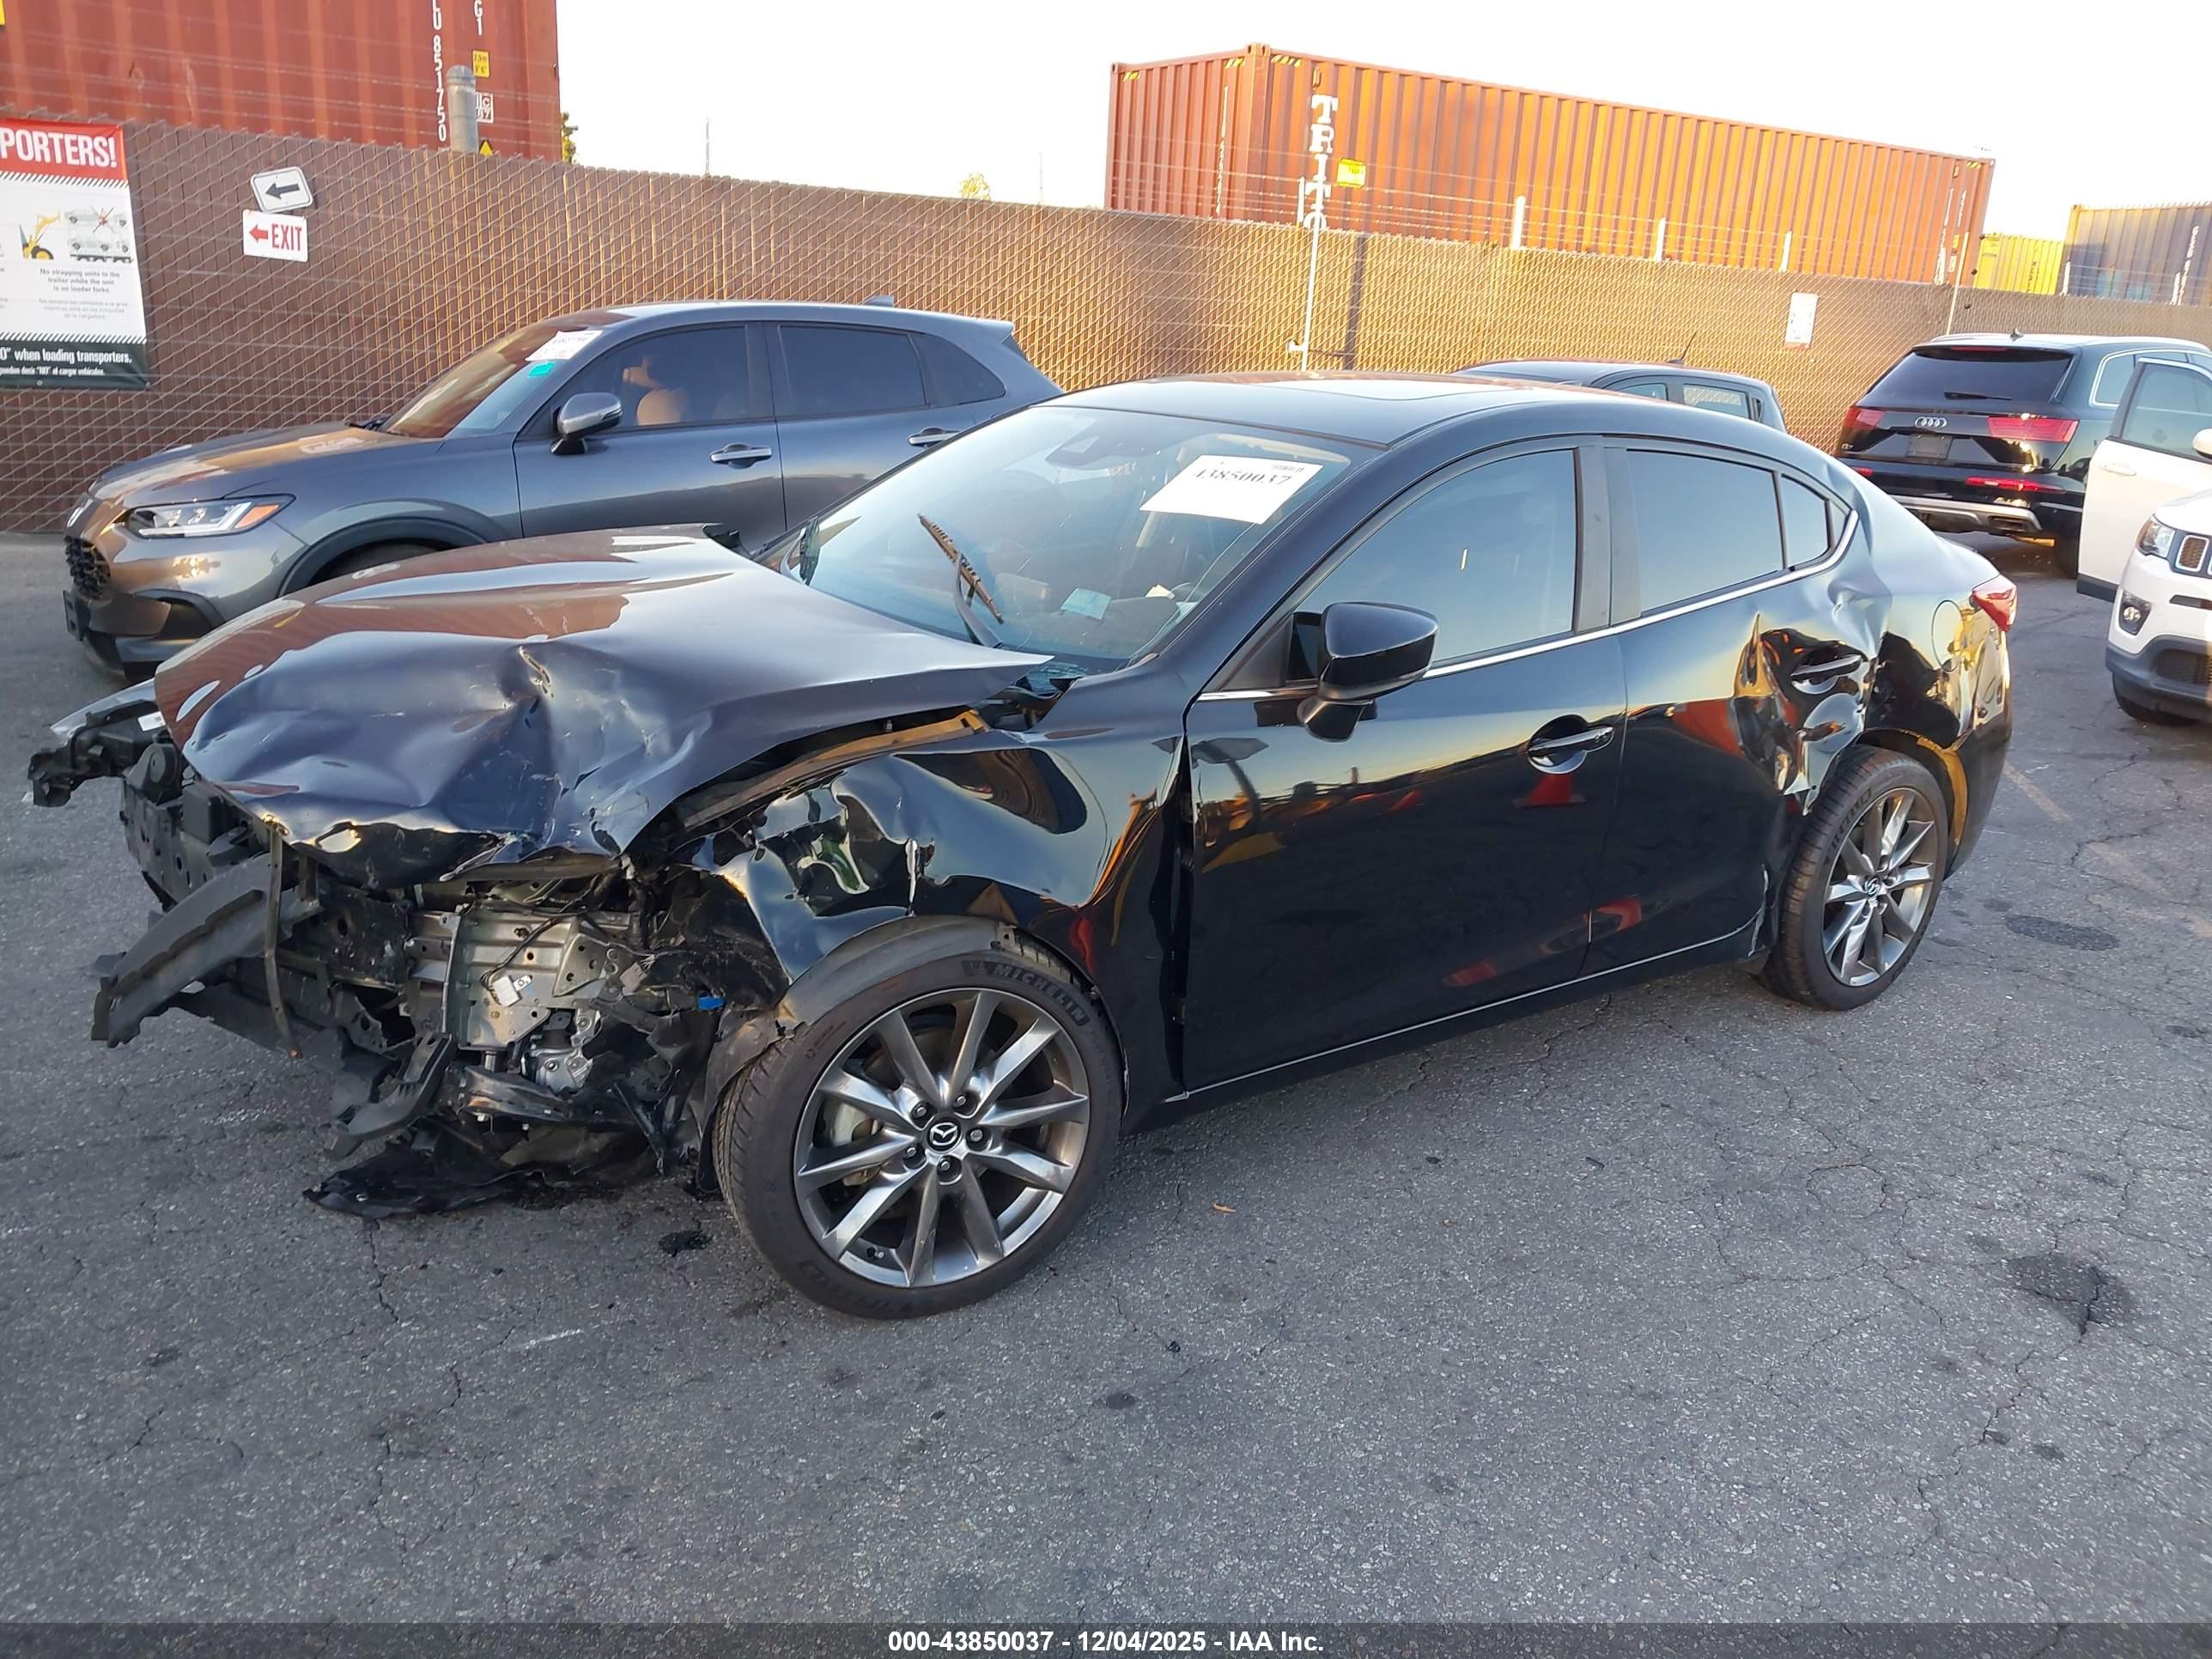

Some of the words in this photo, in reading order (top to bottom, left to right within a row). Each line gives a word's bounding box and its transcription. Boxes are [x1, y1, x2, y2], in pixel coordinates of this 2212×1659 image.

[433, 34, 447, 142] 851750
[0, 127, 117, 167] PORTERS!
[271, 223, 301, 251] EXIT
[15, 348, 40, 362] when
[42, 348, 75, 364] loading
[76, 350, 132, 365] transporters.
